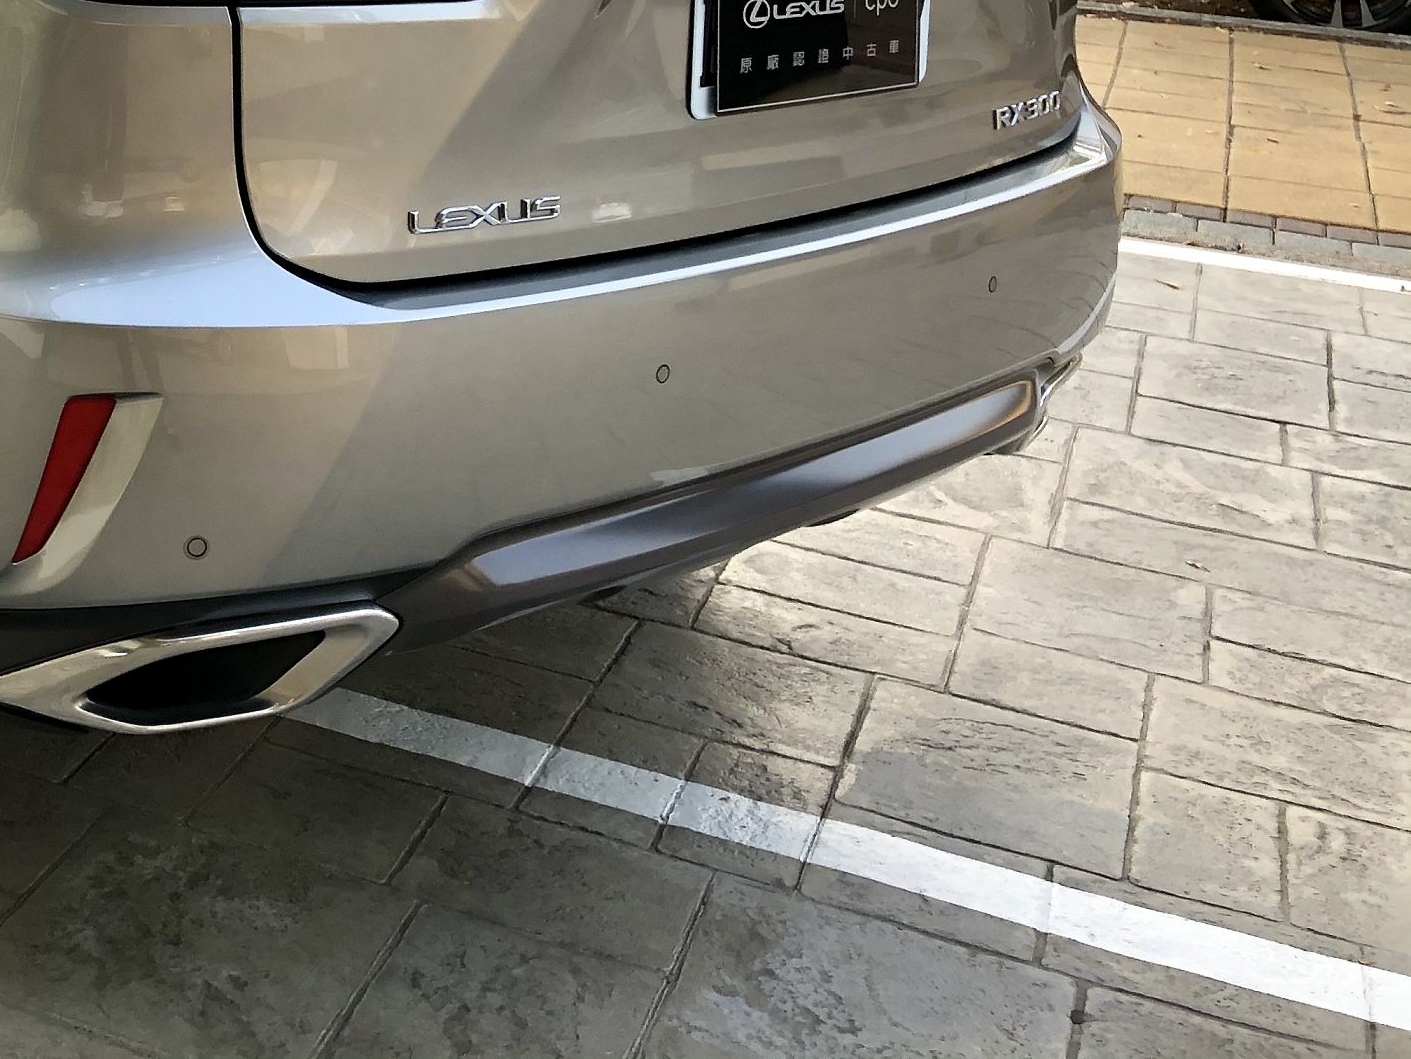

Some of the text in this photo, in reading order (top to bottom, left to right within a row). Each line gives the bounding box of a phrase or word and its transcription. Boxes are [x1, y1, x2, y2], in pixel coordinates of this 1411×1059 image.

[739, 39, 900, 75] 原廠認證中古車
[408, 195, 561, 235] LEXUS
